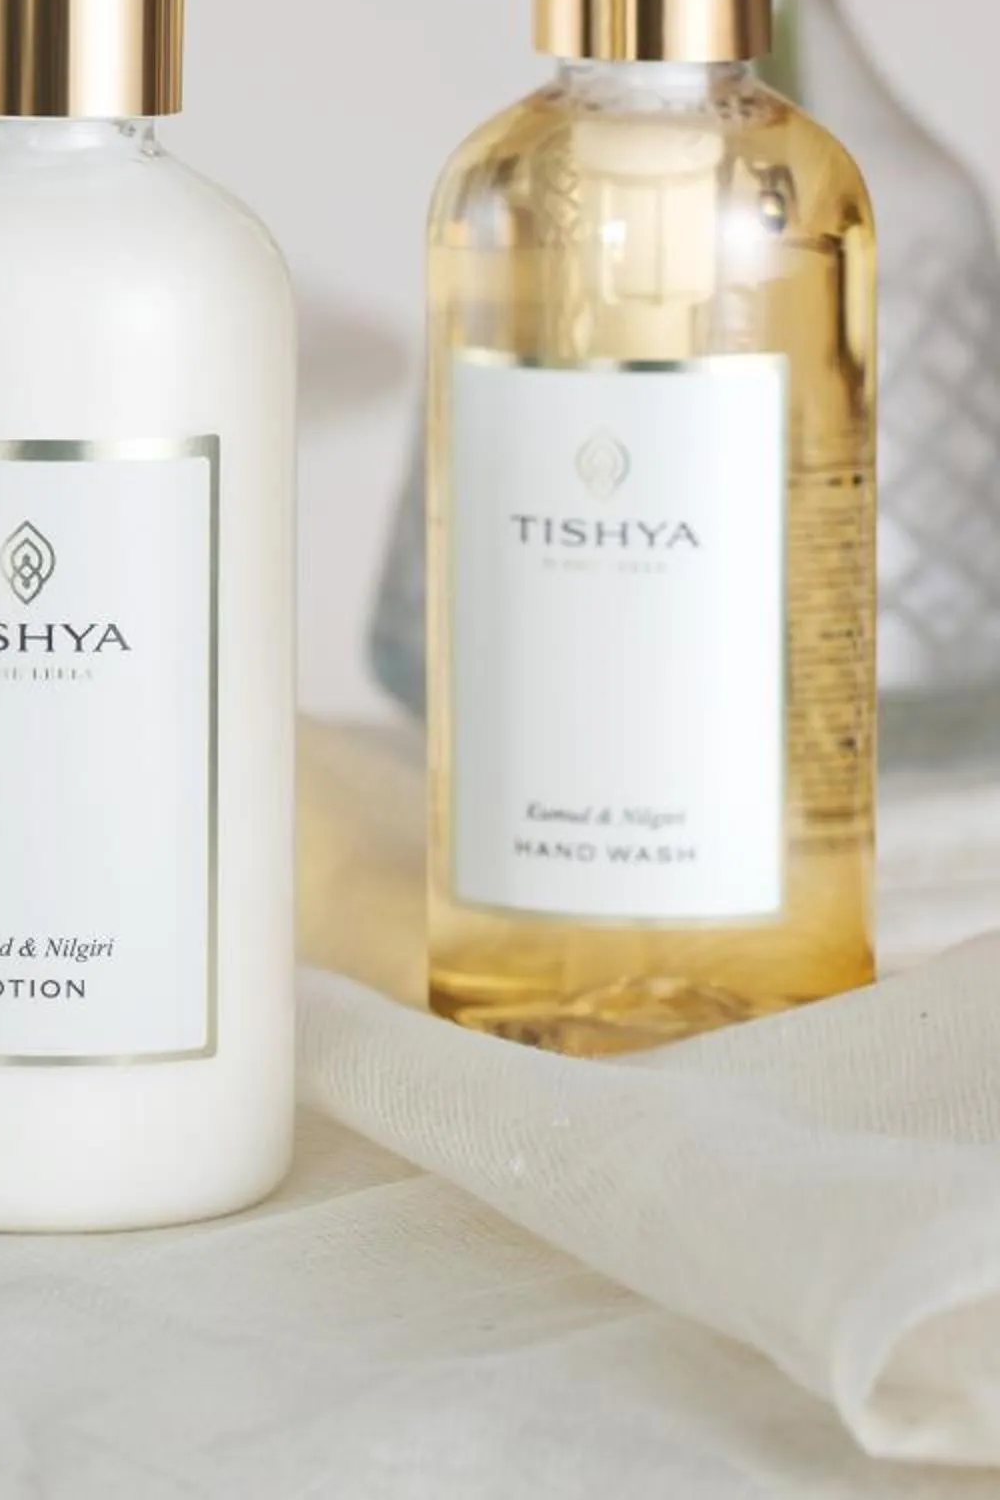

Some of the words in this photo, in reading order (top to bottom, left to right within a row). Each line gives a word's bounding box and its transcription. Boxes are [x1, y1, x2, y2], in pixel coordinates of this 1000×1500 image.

[510, 515, 701, 549] TISHYA
[513, 837, 597, 863] HAND
[606, 845, 696, 864] WASH
[18, 938, 36, 957] &
[45, 938, 114, 962] Nilgiri
